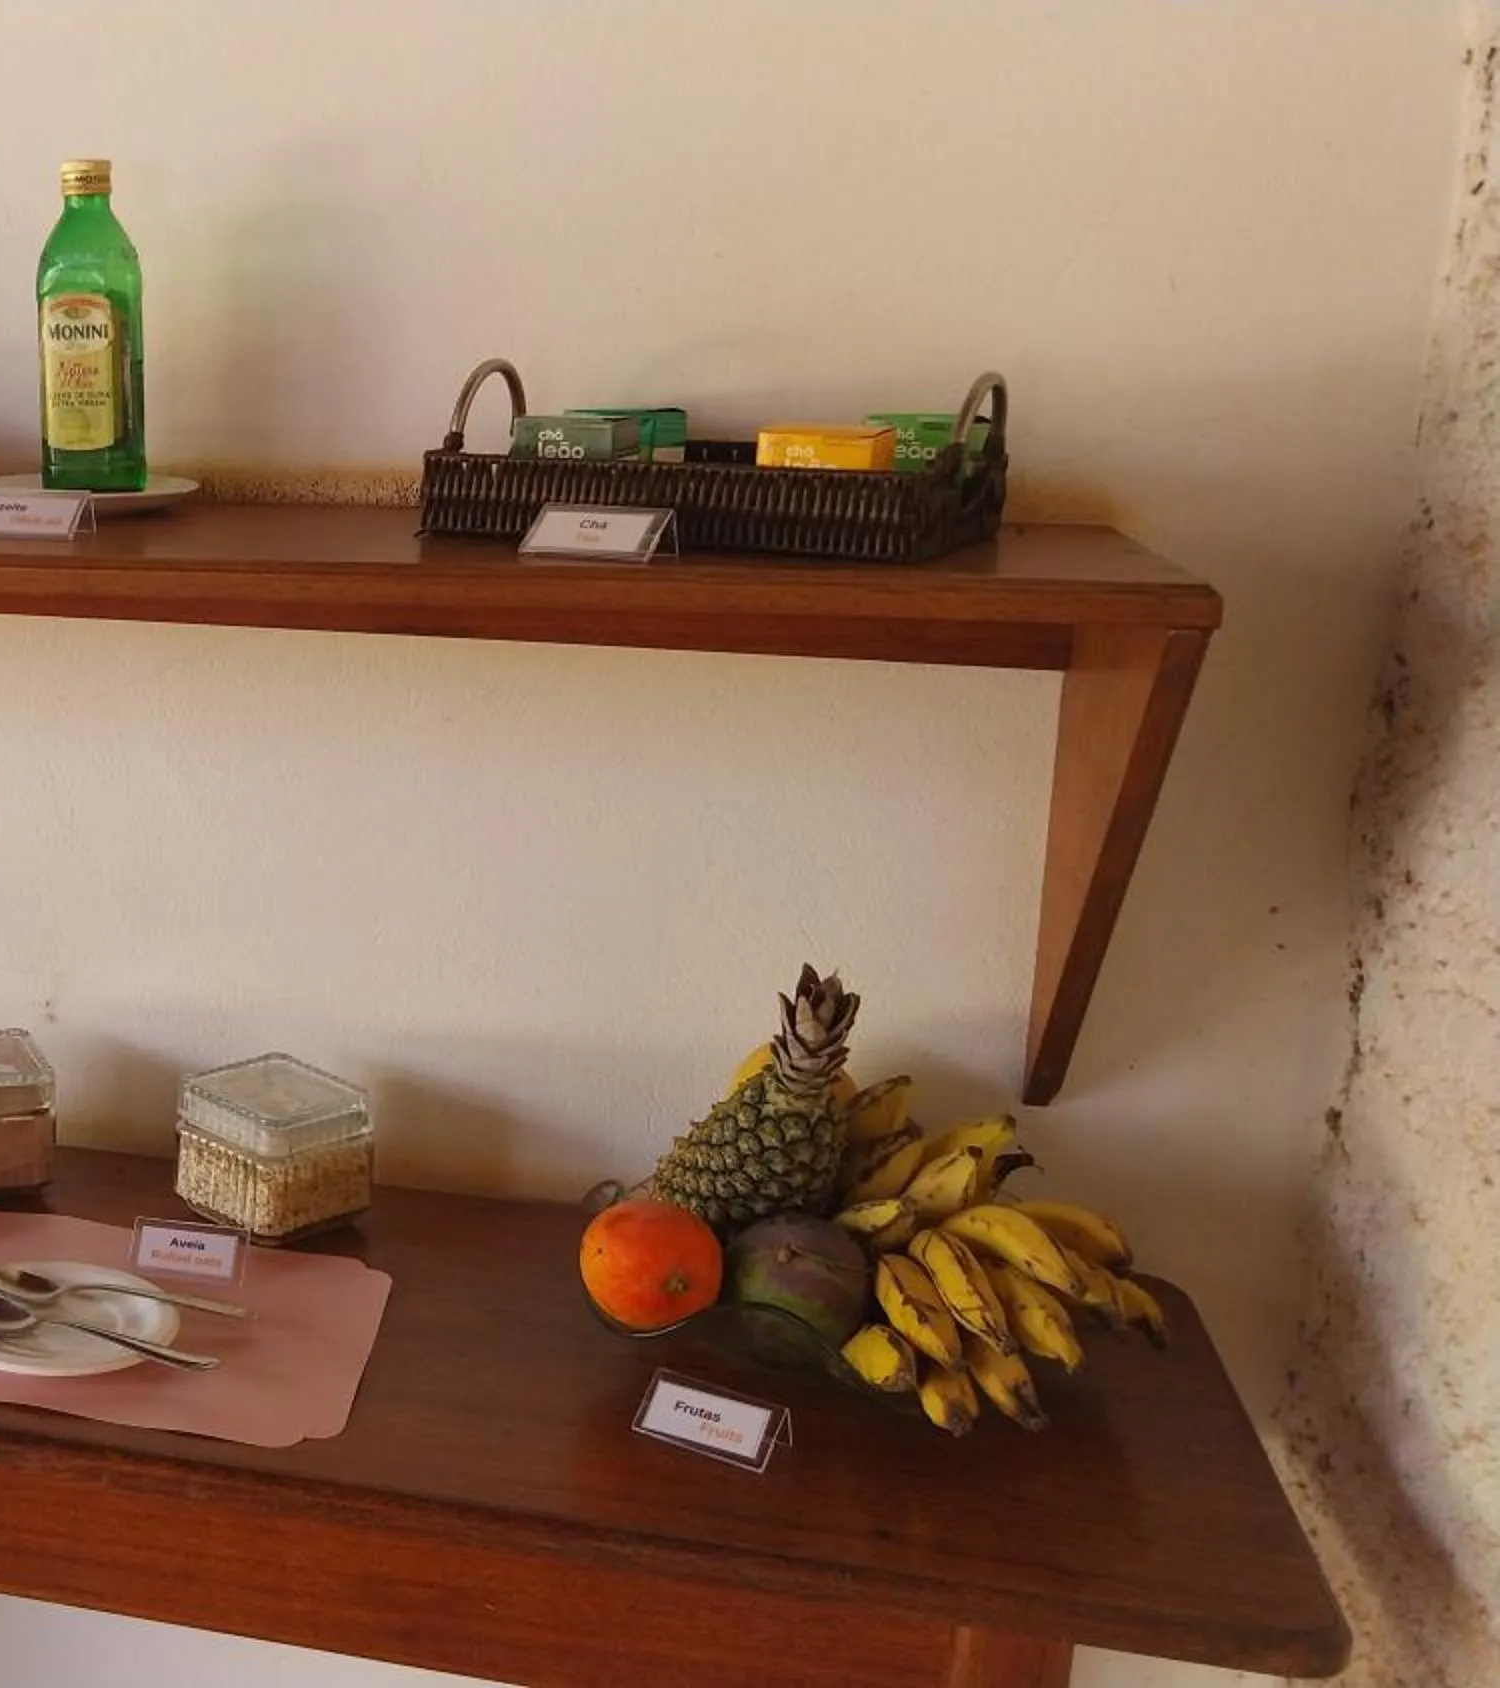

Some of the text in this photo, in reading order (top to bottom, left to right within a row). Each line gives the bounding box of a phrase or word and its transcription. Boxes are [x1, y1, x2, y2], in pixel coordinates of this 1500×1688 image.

[50, 323, 109, 341] MONINI
[895, 441, 937, 460] eão
[169, 1236, 205, 1251] Aveia
[673, 1399, 721, 1422] Frutas
